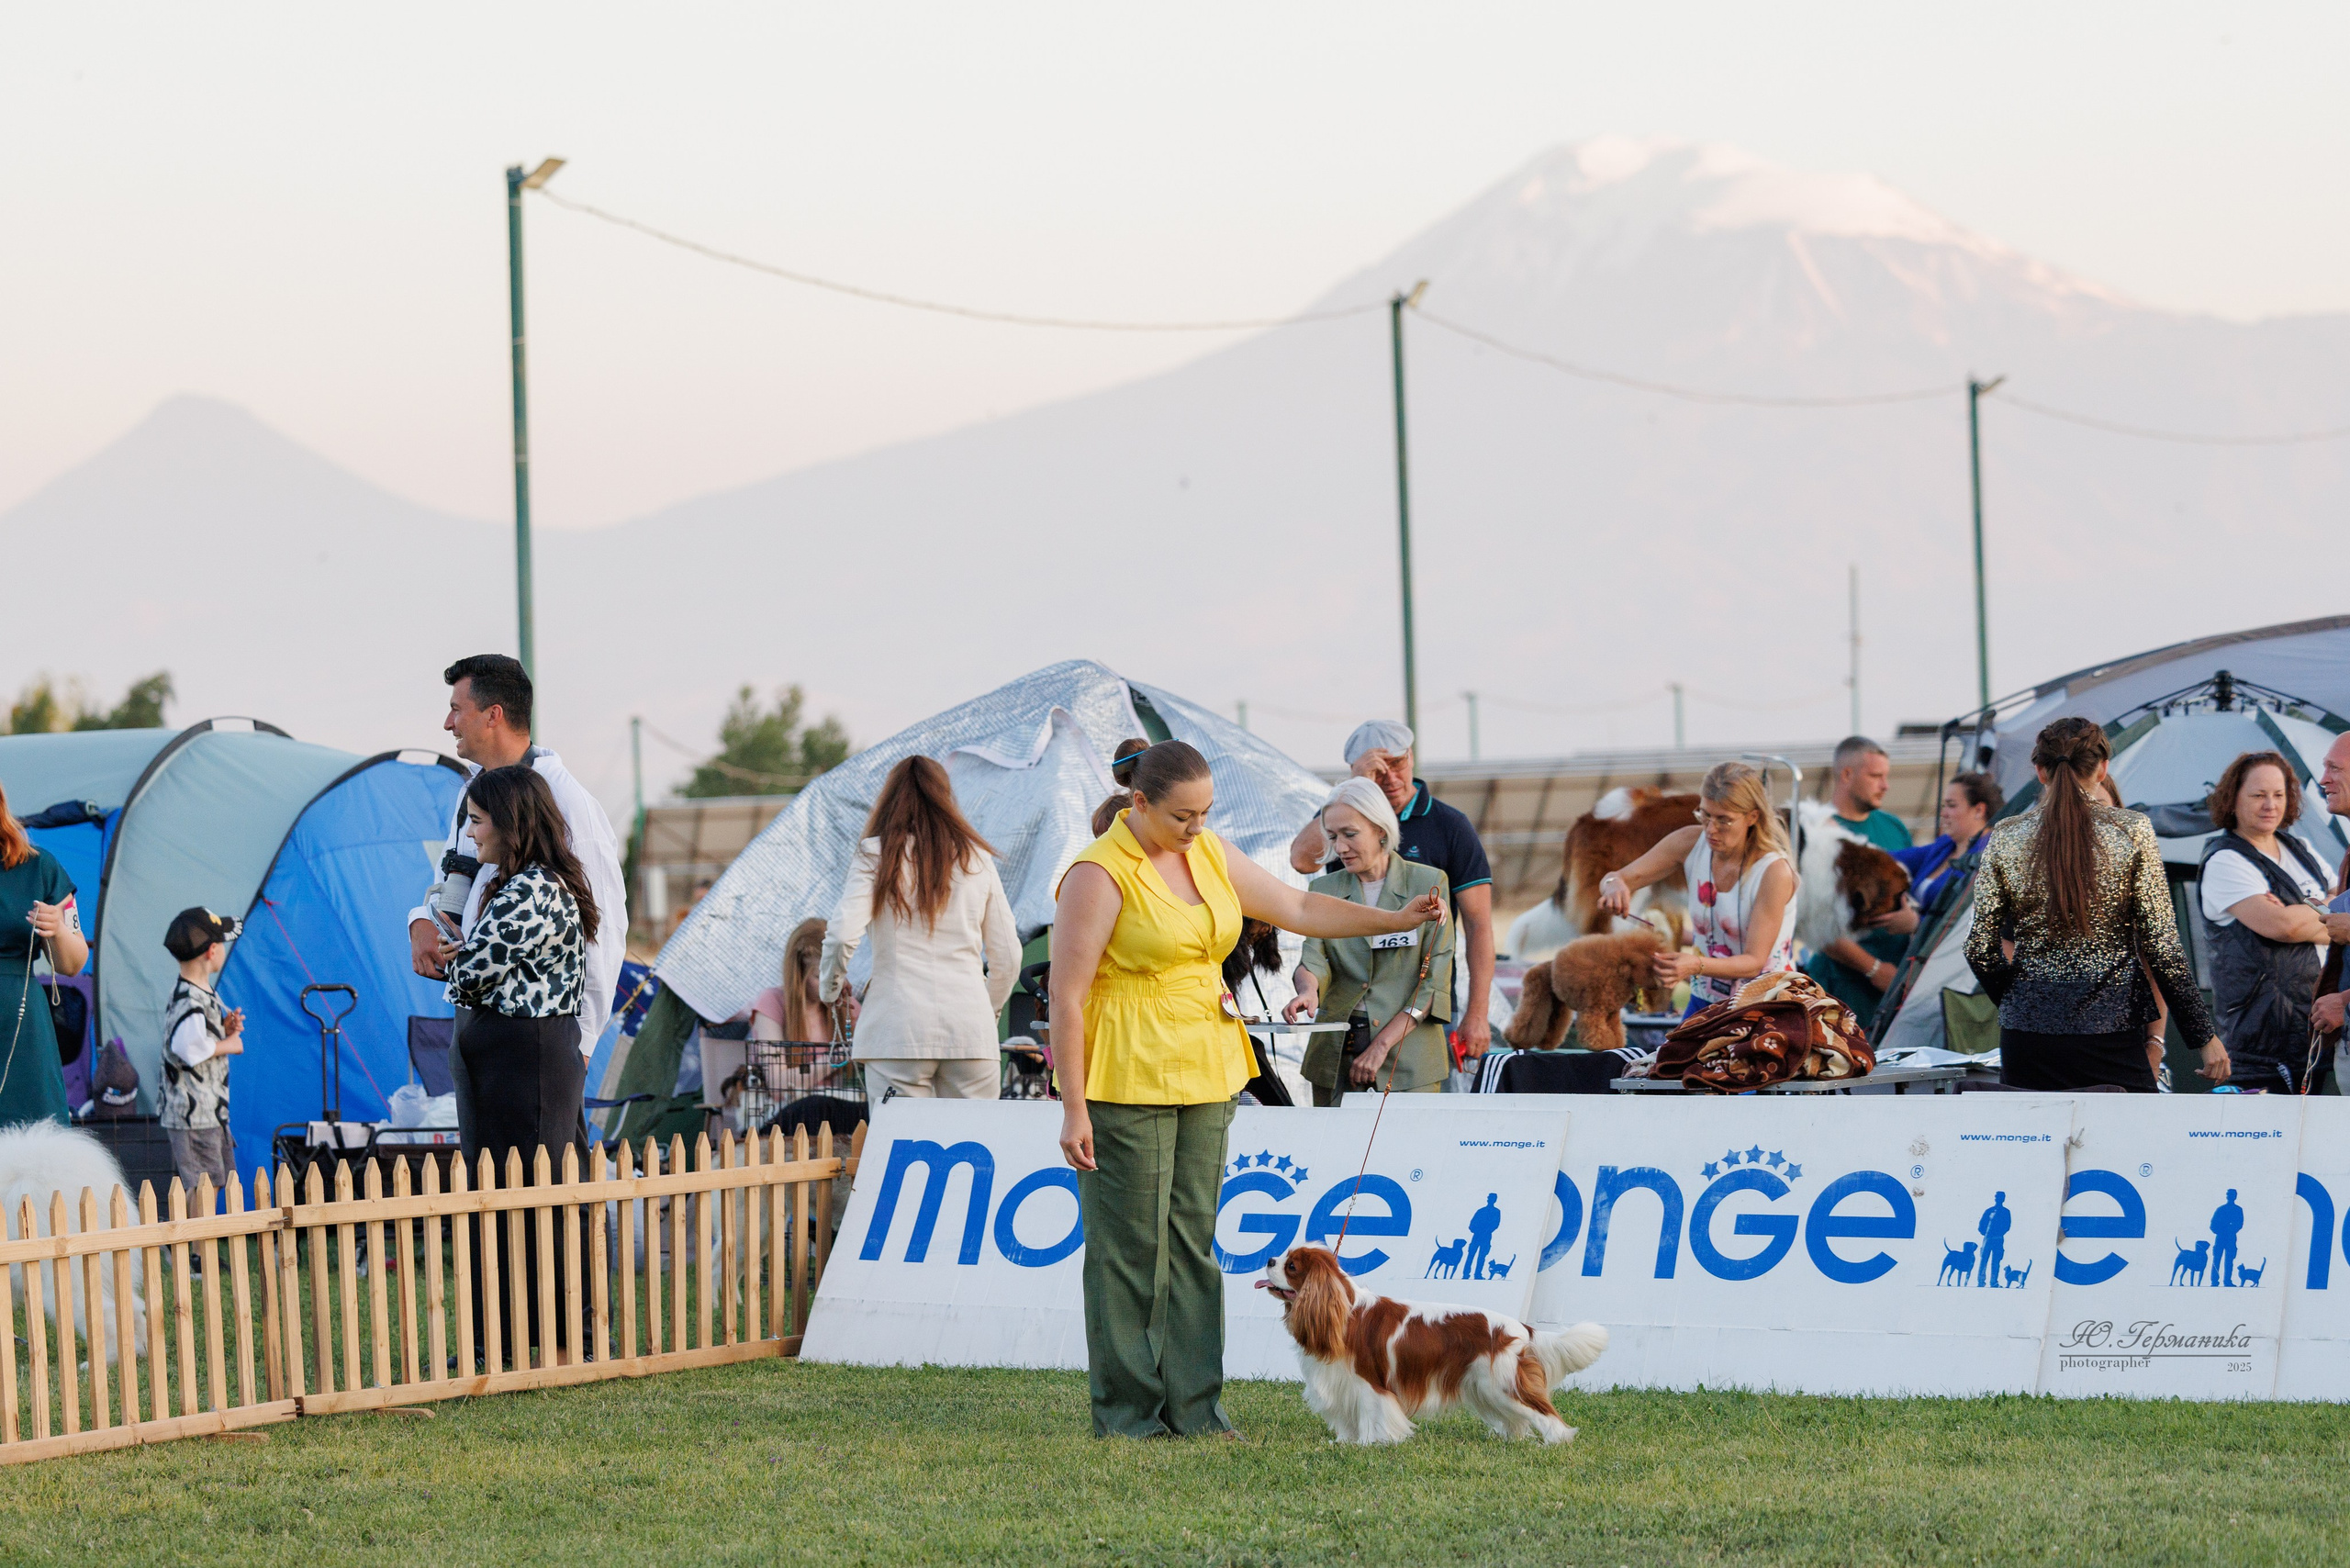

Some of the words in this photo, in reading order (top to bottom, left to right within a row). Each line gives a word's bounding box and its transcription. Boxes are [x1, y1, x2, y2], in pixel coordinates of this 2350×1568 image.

[1379, 936, 1409, 947] 163
[1960, 1134, 2052, 1144] www.monge.it
[2188, 1129, 2283, 1139] www.monge.it
[1459, 1140, 1546, 1149] www.monge.it
